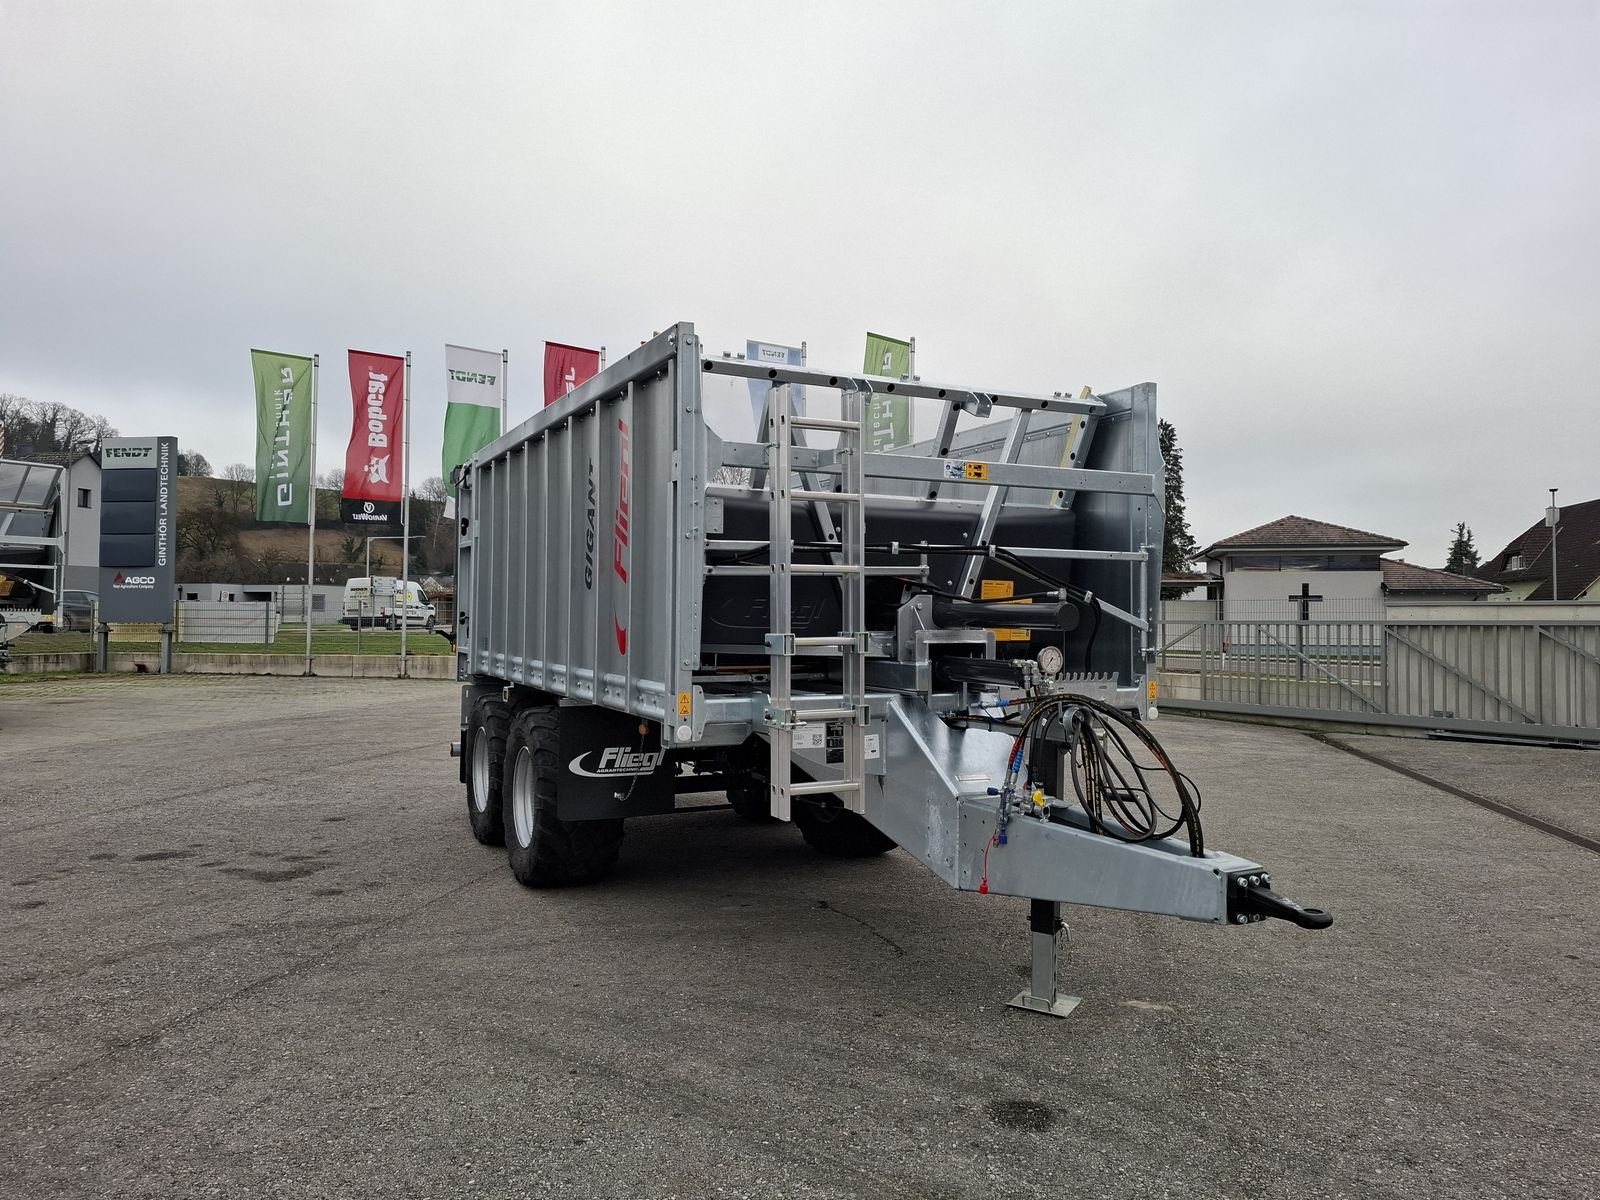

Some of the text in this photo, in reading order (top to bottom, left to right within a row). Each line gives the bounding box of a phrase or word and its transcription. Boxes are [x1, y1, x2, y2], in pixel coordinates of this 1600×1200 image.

[105, 447, 152, 458] FENDT
[157, 442, 169, 567] GINTHÖR LANDTECHNIK
[584, 457, 596, 590] GIGANT
[125, 576, 155, 584] AGCO
[598, 746, 666, 771] Fliegl
